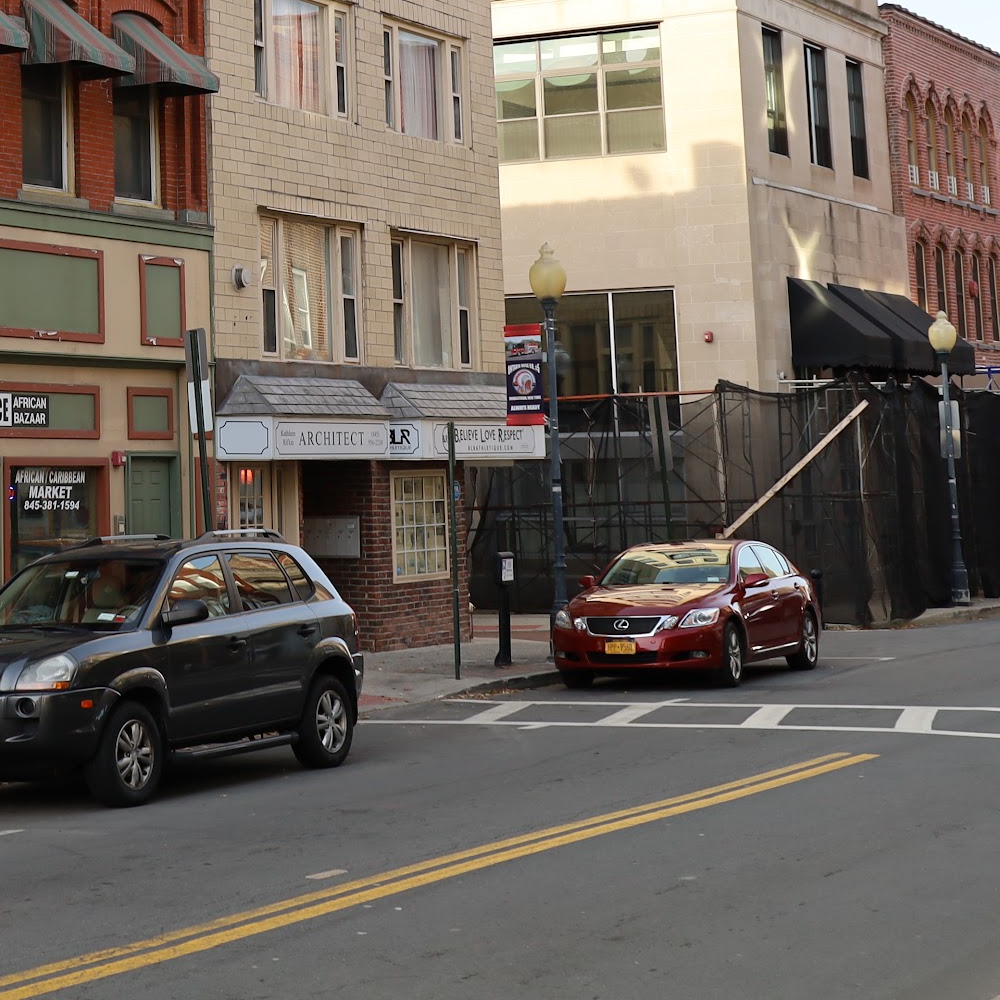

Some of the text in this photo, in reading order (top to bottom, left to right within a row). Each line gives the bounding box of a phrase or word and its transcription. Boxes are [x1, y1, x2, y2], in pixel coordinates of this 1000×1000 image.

[13, 396, 47, 409] AFRICAN
[14, 412, 46, 425] BAZAAR
[299, 431, 365, 446] ARCHITECT
[480, 428, 496, 442] LOVE
[498, 428, 523, 442] RESPECT
[29, 486, 72, 499] MARKET
[24, 500, 80, 510] 845-381-1594
